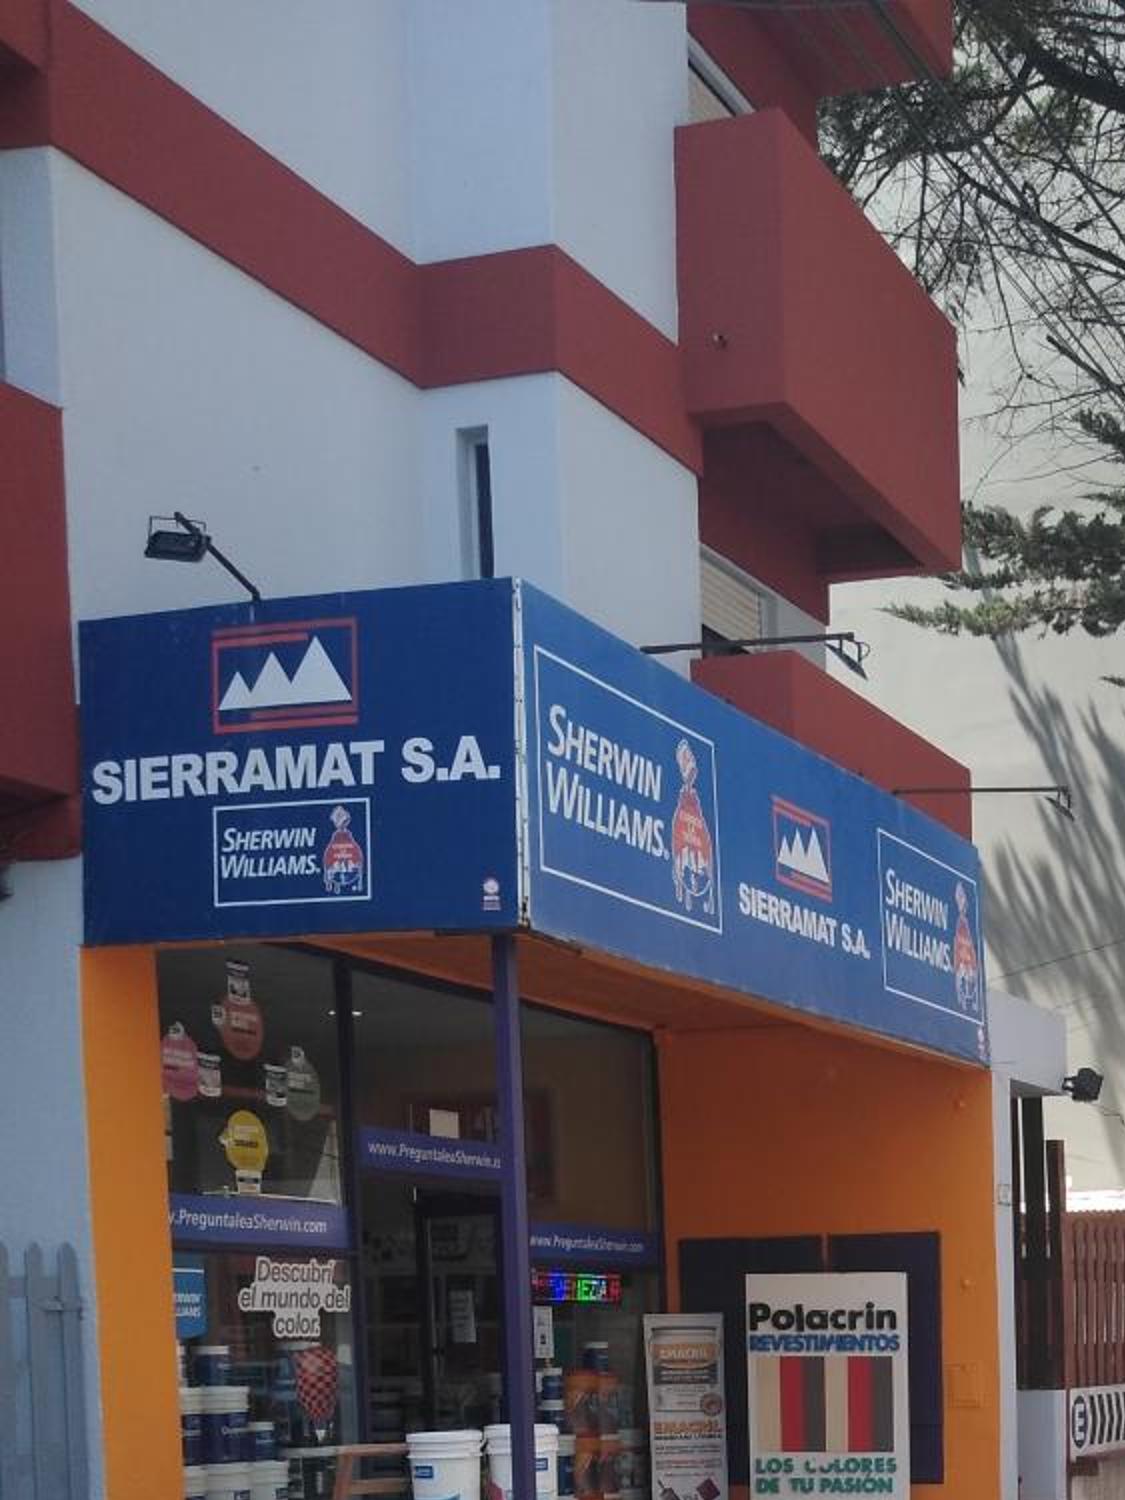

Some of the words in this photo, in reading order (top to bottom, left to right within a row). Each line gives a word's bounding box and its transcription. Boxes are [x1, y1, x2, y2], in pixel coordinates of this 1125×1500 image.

[547, 704, 662, 802] SHERWIN
[92, 740, 384, 804] SIERRAMAT
[401, 736, 500, 783] S.A.
[222, 827, 317, 853] SHERWIN
[885, 868, 949, 930] SHERWIN
[738, 882, 837, 948] SIERRAMAT
[841, 923, 871, 960] S.A.
[239, 1285, 257, 1310] el
[261, 1288, 321, 1310] mundo
[324, 1285, 351, 1311] del
[748, 1302, 897, 1332] Polacrin
[748, 1333, 901, 1353] REVESTIMIENTOS
[755, 1458, 795, 1475] LOS
[755, 1477, 780, 1494] DE
[788, 1477, 815, 1493] TU
[819, 1471, 894, 1494] PASIÓN
